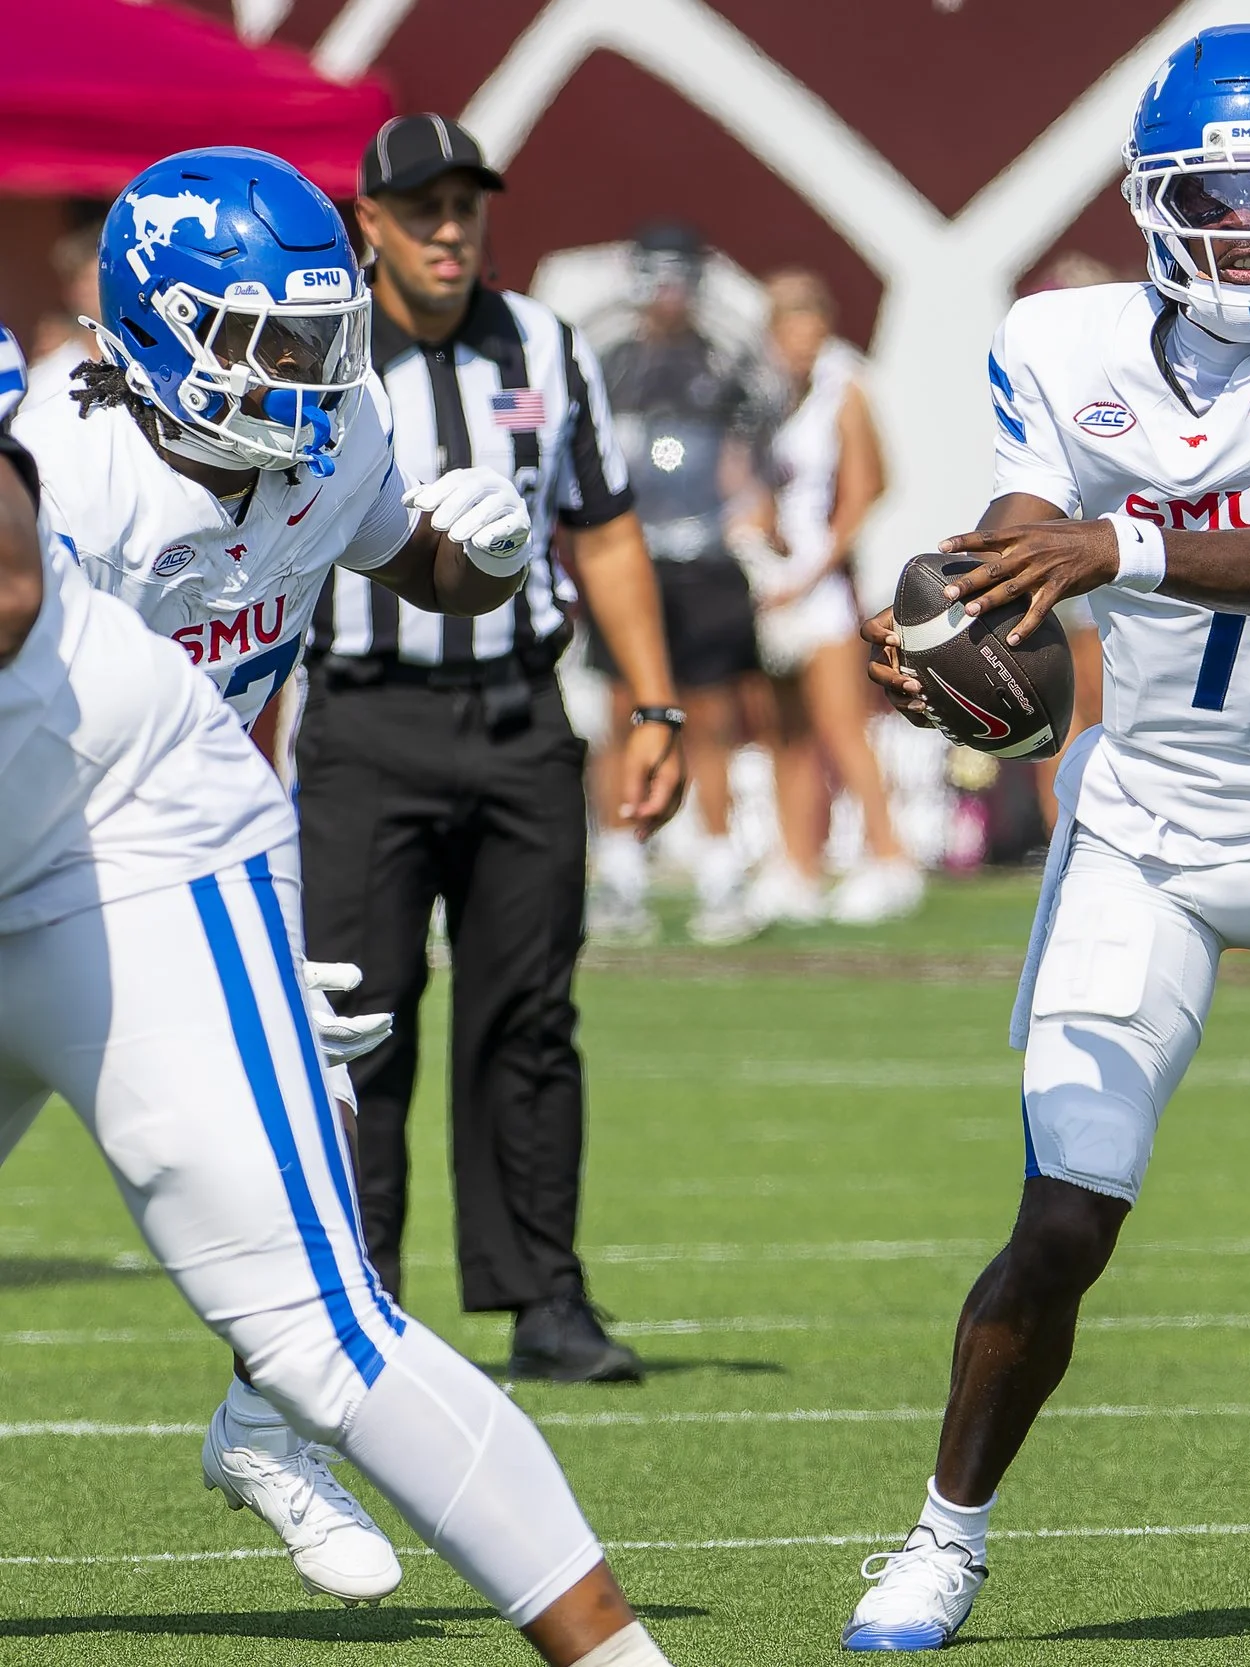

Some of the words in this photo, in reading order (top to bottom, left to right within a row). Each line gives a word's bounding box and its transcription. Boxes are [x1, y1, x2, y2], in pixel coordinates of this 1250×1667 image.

[303, 271, 341, 287] SMU
[234, 285, 260, 296] Dallas
[1085, 410, 1127, 424] ACC
[158, 550, 188, 567] ACC
[171, 593, 287, 666] SMU
[980, 645, 1012, 682] ELITE
[1007, 678, 1035, 716] VAPOR
